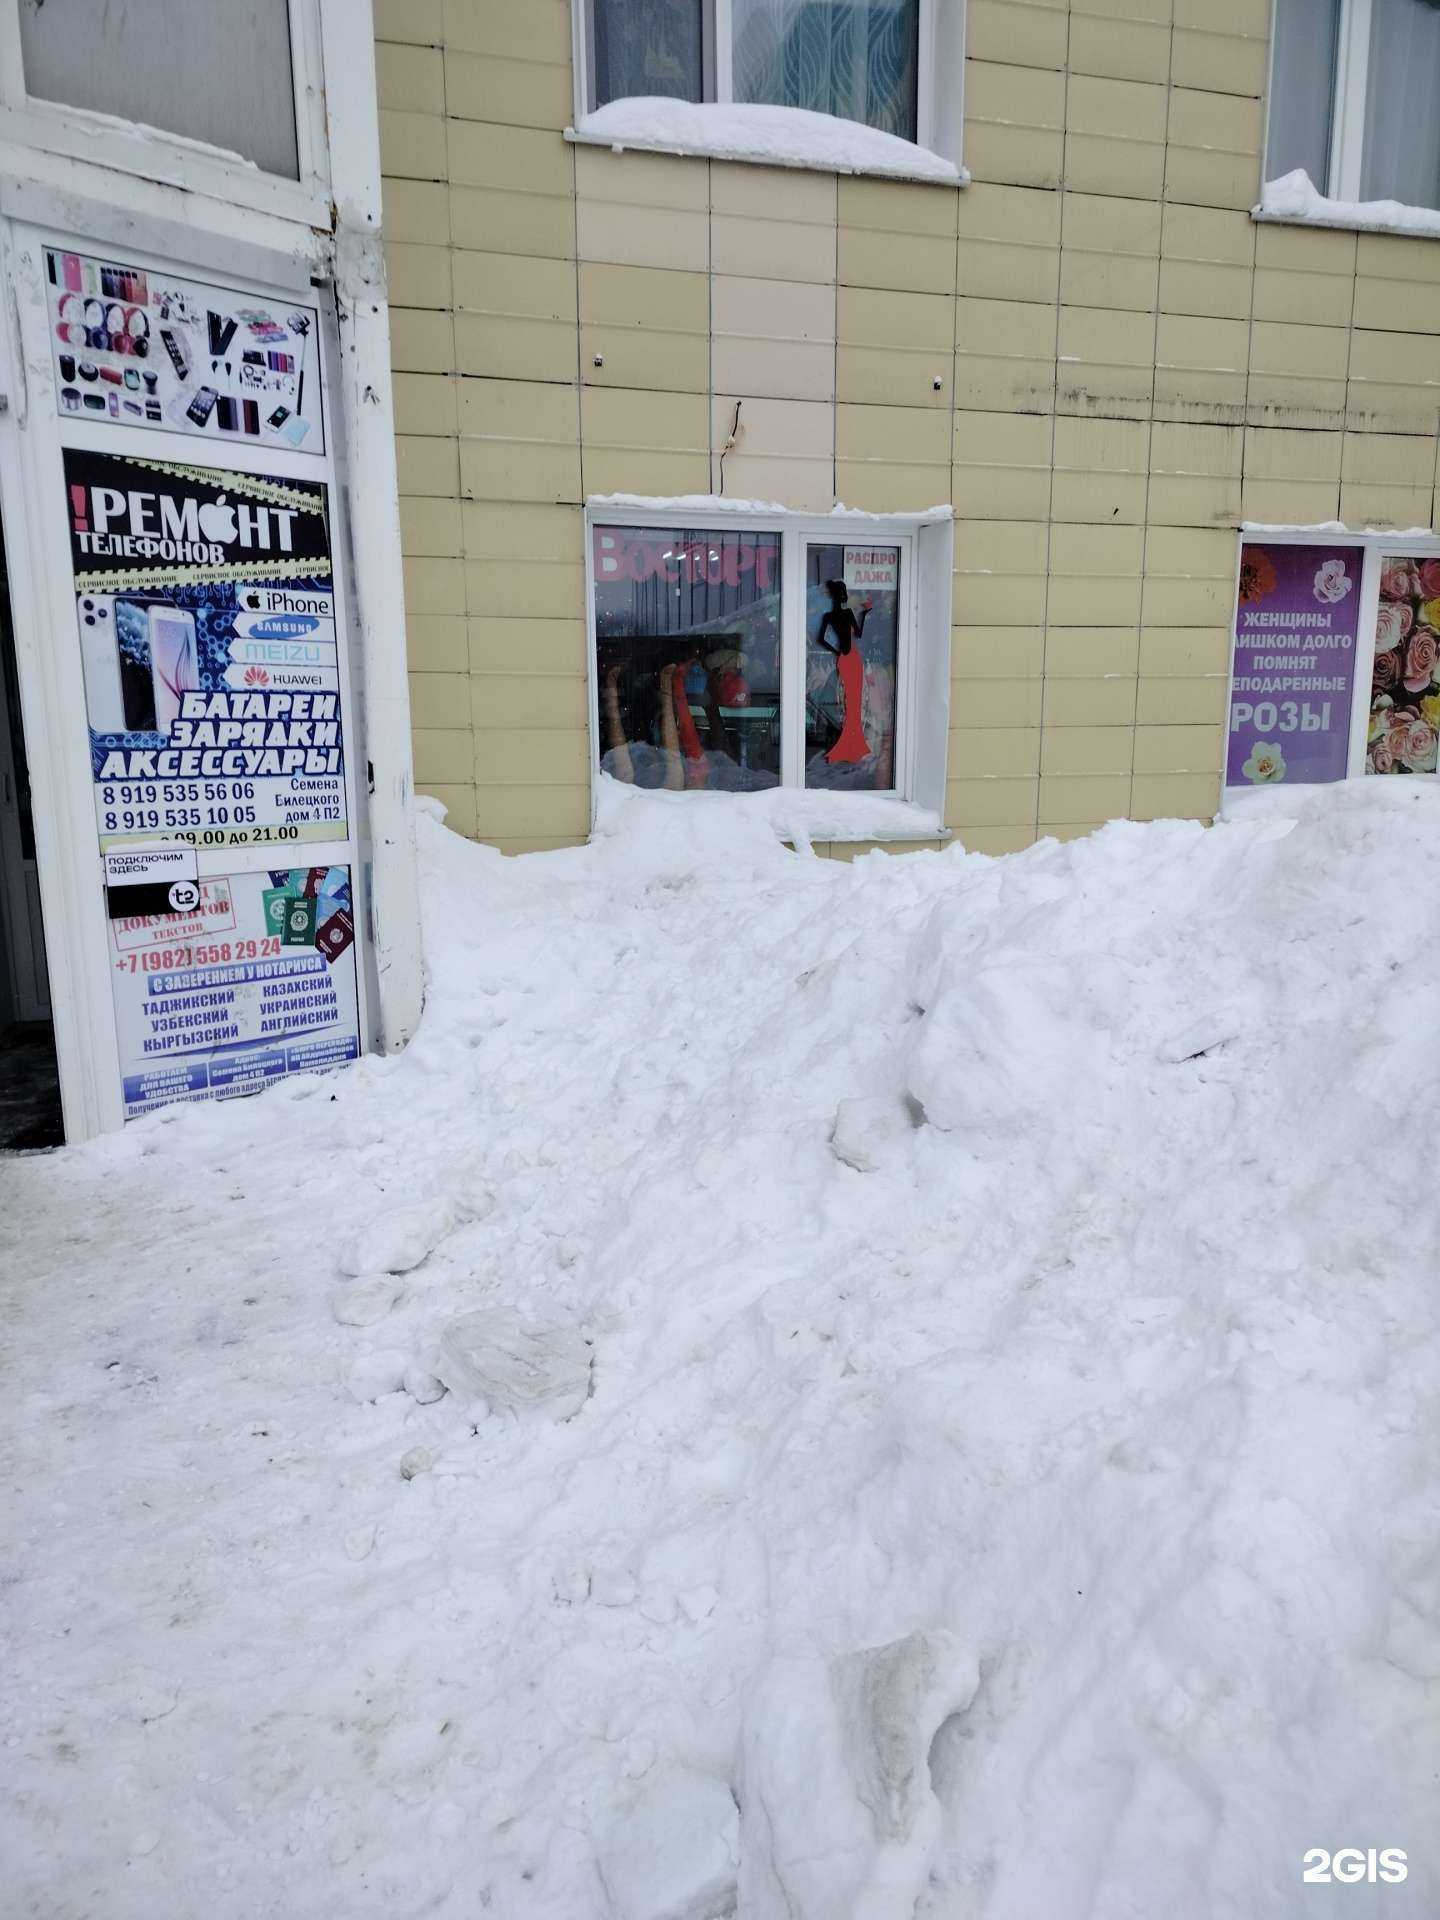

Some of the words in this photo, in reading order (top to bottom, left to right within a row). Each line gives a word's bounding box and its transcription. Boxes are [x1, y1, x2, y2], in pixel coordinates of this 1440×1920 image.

[75, 530, 225, 564] ТЕЛЕФОНОВ
[846, 551, 897, 565] РАСПРО
[855, 570, 893, 584] ДАЖА
[266, 591, 329, 615] iPhone
[256, 620, 313, 633] SAMSUNG
[1243, 611, 1333, 630] ЖЕНЩИНЫ
[1233, 633, 1301, 649] ЛИШКОМ
[1302, 633, 1353, 651] ДОЛГО
[244, 643, 321, 662] MEIZU
[1252, 655, 1319, 670] ПОМНЯТ
[272, 674, 322, 686] HUAWEI
[1231, 676, 1347, 694] ЕПОДАРЕННЫЕ
[1230, 701, 1333, 733] РОЗЫ
[170, 720, 338, 748] ЗАРЯДКИ
[99, 748, 341, 779] АКСЕССУАРЫ
[103, 786, 116, 805] 8
[120, 784, 157, 804] 919
[163, 783, 199, 802] 535
[204, 782, 228, 801] 56
[231, 781, 255, 800] 06
[290, 777, 339, 791] Семена
[274, 793, 340, 807] Билецкого
[105, 811, 118, 831] 8
[122, 810, 159, 830] 919
[165, 808, 201, 827] 535
[208, 807, 229, 825] 10
[233, 805, 256, 824] 05
[285, 811, 310, 824] дом
[312, 807, 321, 820] 4
[324, 806, 341, 820] П2
[228, 832, 248, 845] до
[252, 825, 299, 843] 21.00
[175, 888, 195, 905] t2
[152, 922, 204, 940] ТЕКСТОВ
[115, 953, 138, 974] +7
[141, 944, 192, 972] (982)
[196, 942, 232, 965] 558
[235, 940, 258, 961] 29
[260, 937, 282, 957] 24
[152, 977, 163, 994] С
[164, 966, 245, 992] ЗАВЕРЕНИЕМ
[246, 963, 256, 979] У
[256, 956, 323, 978] НОТАРИУСА
[262, 976, 333, 997] КАЗАХСКИЙ
[141, 990, 236, 1017] ТАДЖИКСКИЙ
[259, 992, 338, 1016] УКРАИНСКИЙ
[151, 1008, 229, 1034] УЗБЕКСКИЙ
[260, 1008, 339, 1033] АНГЛИЙСКИЙ
[143, 1024, 240, 1053] КЫРГЫЗСКИЙ
